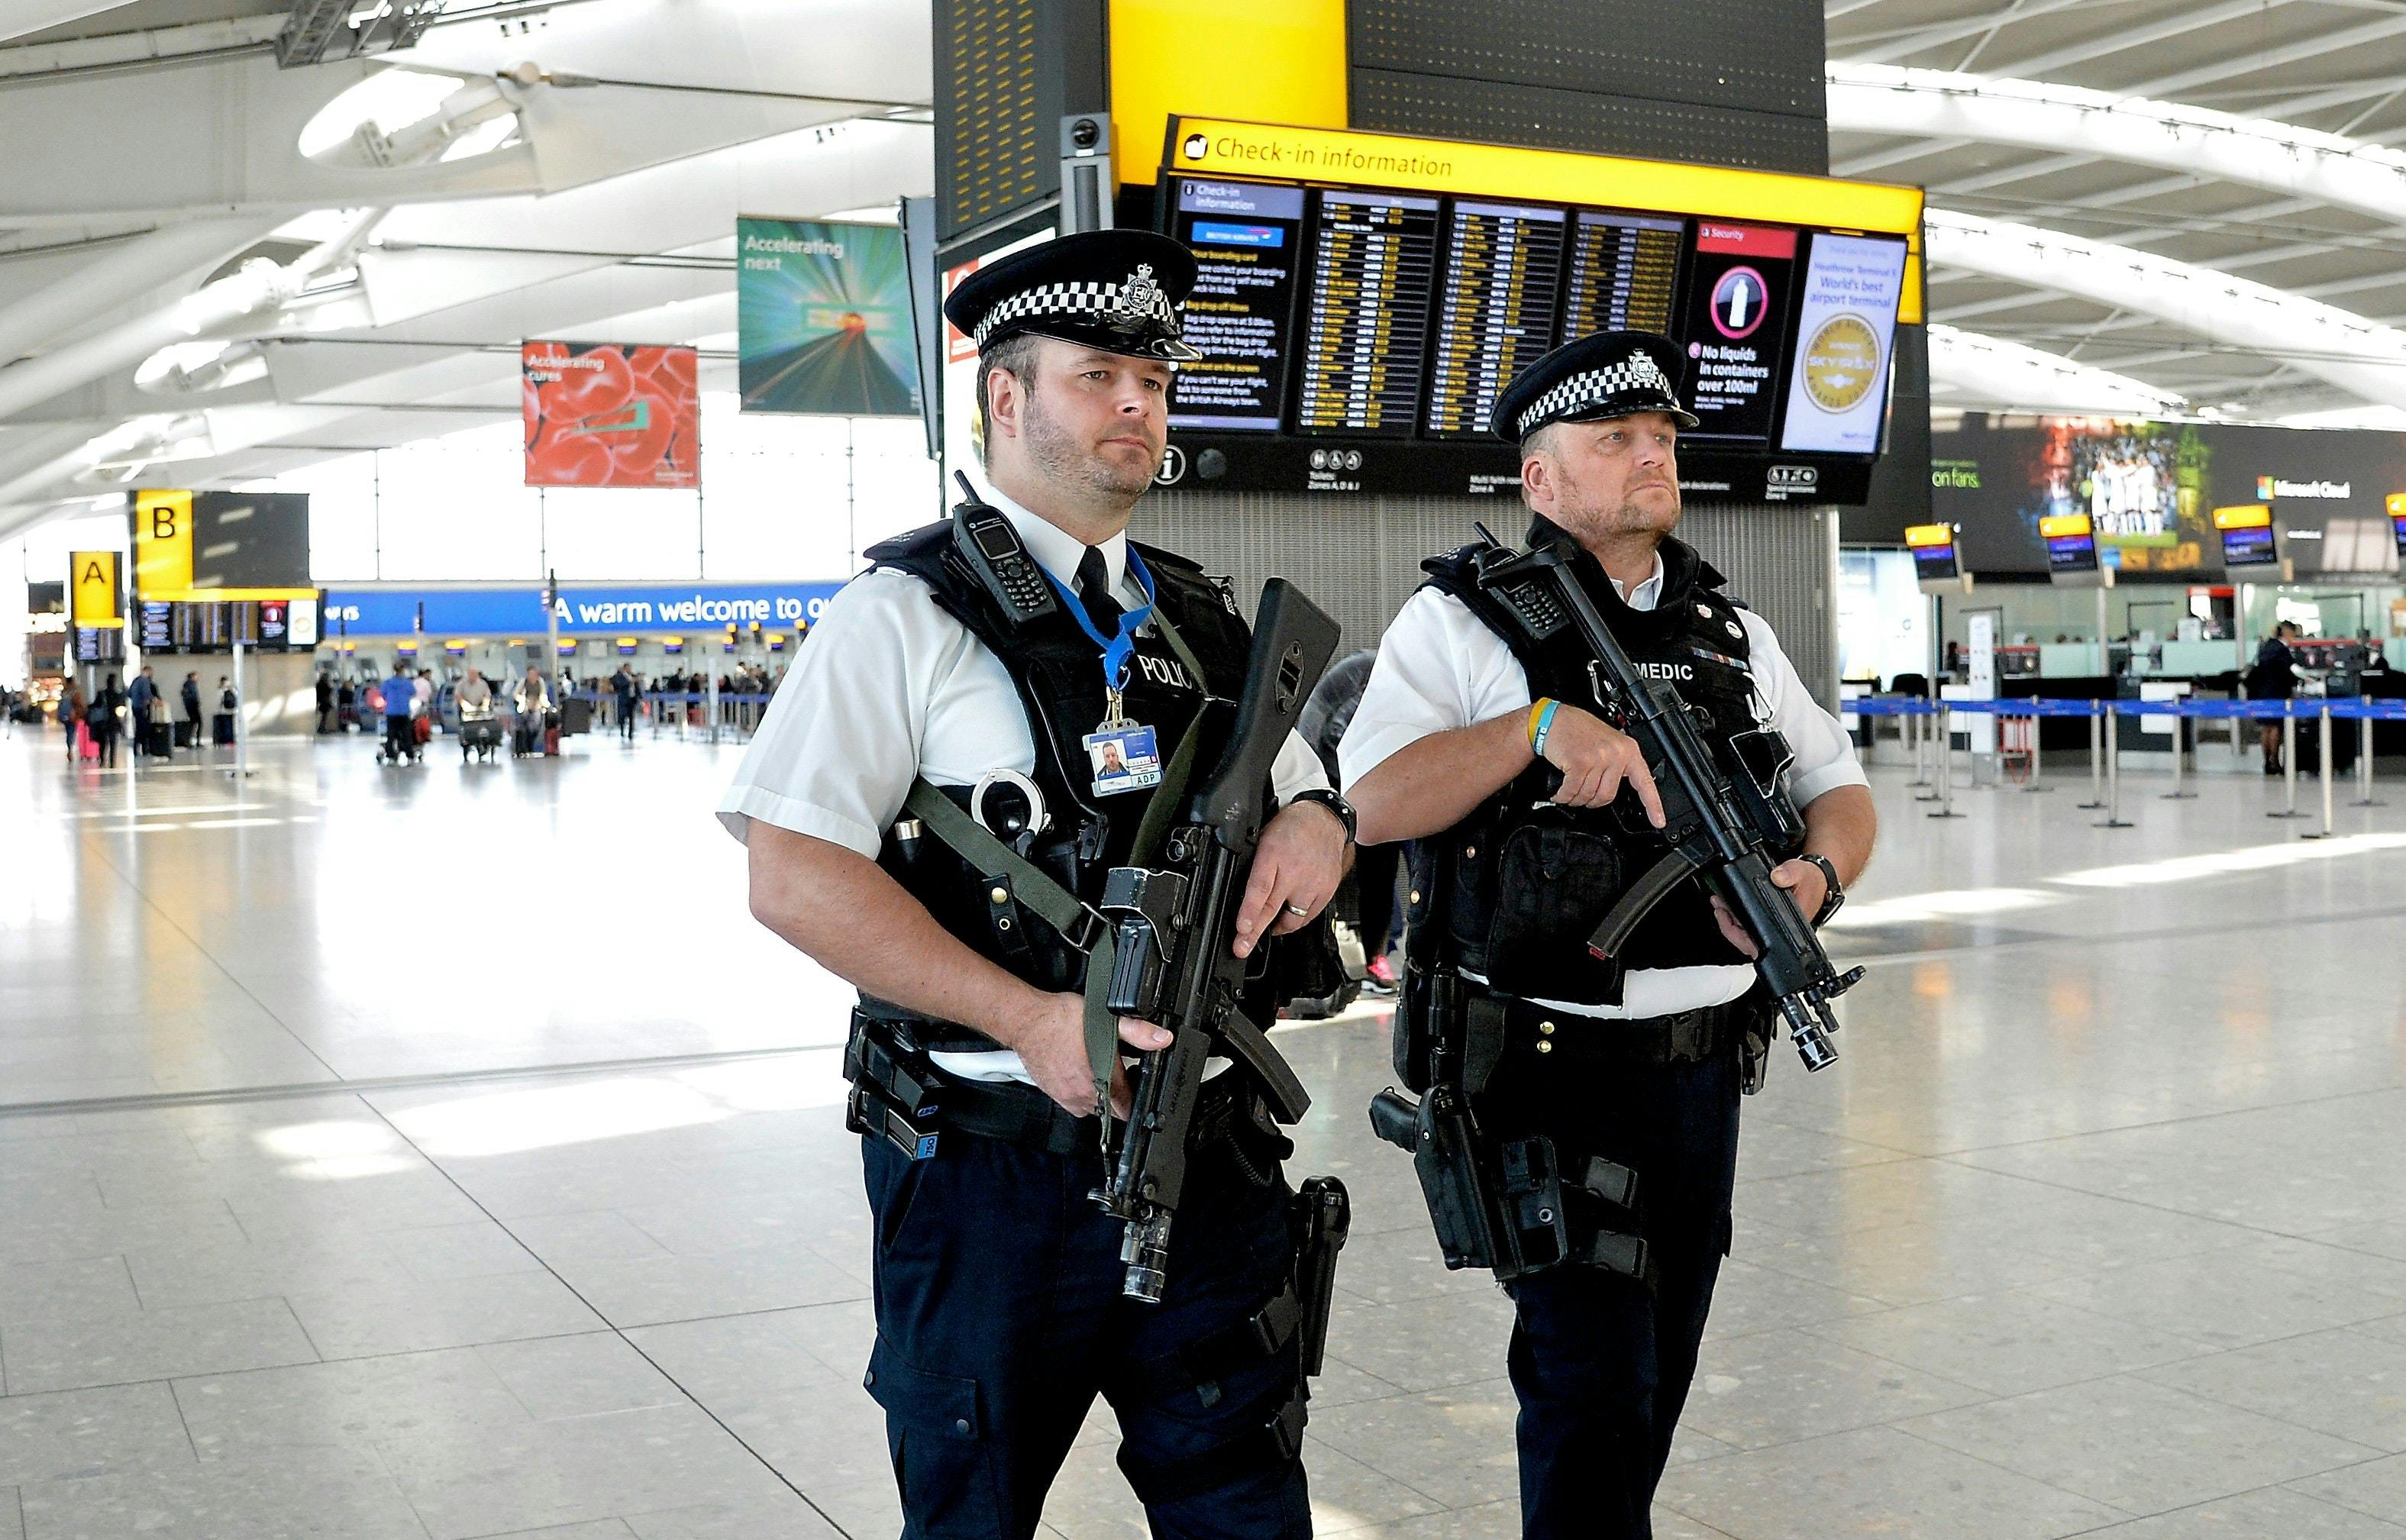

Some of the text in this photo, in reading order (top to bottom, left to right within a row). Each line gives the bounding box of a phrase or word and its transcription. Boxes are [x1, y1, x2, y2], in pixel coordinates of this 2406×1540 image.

[1216, 137, 1452, 176] Check-in information
[1711, 228, 1745, 242] Security
[745, 235, 844, 259] Accelerating
[745, 257, 781, 271] next
[1702, 345, 1757, 363] No liquids
[528, 355, 605, 372] Accelerating
[1699, 360, 1769, 379] in containers
[528, 371, 563, 382] cures
[1697, 379, 1759, 394] over 100ml
[1932, 470, 1949, 488] on
[2274, 480, 2350, 498] Microsoft Cloud
[153, 507, 175, 538] B
[83, 561, 105, 583] A
[555, 598, 575, 624] A
[579, 600, 652, 624] warm
[658, 594, 770, 622] welcome
[776, 597, 803, 620] to
[1137, 654, 1193, 689] POLIC
[1633, 663, 1694, 680] MEDIC
[1137, 773, 1156, 785] ADP
